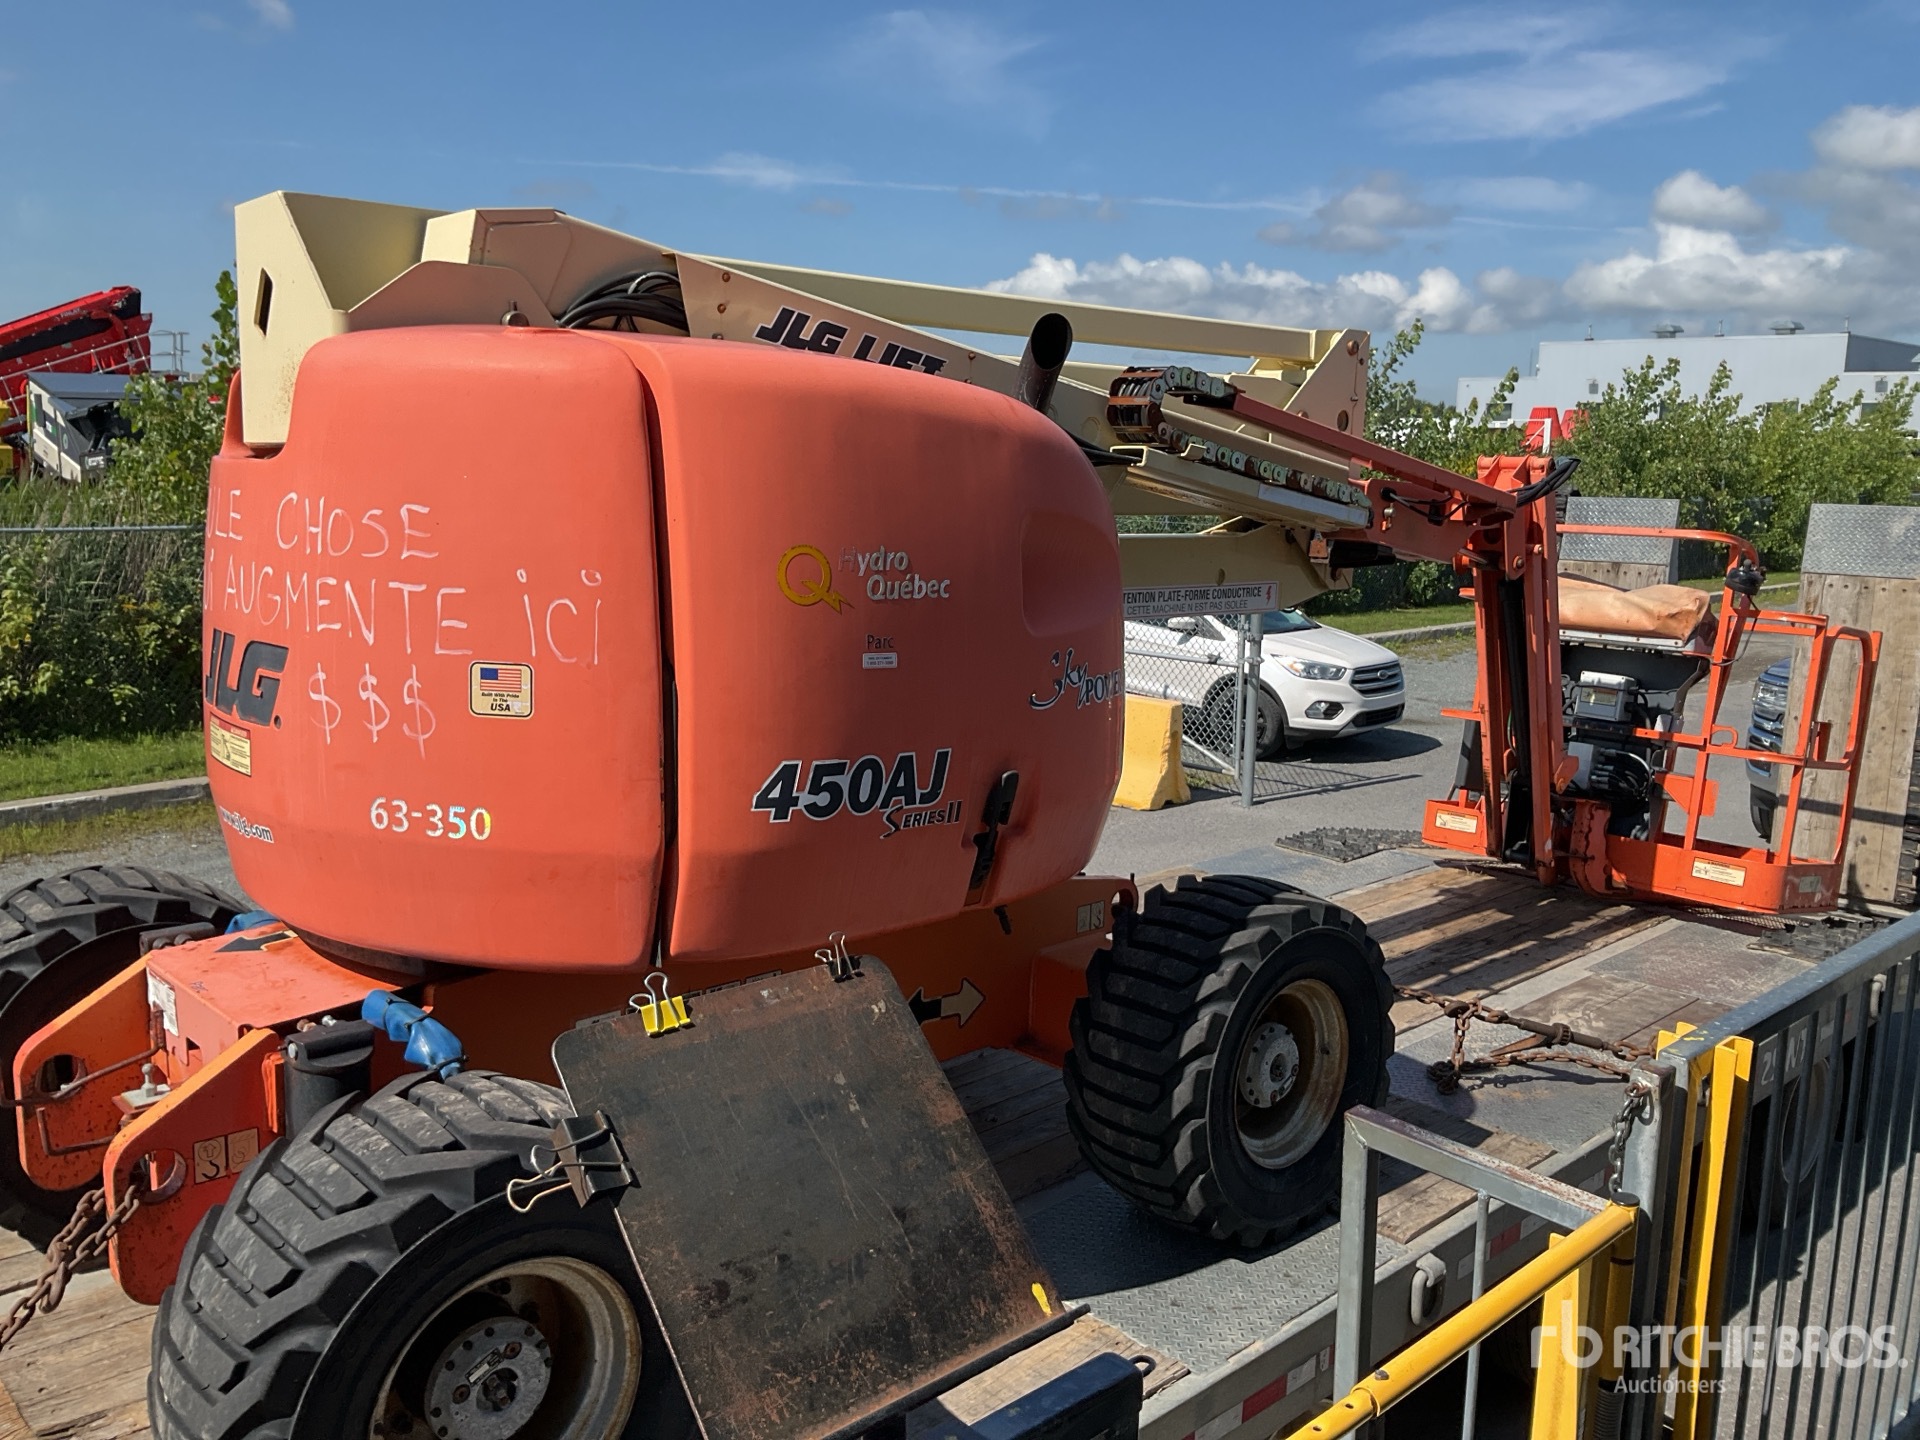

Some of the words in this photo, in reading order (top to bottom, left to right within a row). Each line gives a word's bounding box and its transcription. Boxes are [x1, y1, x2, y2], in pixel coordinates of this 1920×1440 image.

[753, 305, 850, 355] JLG
[276, 491, 439, 559] CHOSE
[223, 553, 473, 655] AUGMENTE
[866, 573, 951, 601] Québec
[1127, 604, 1151, 616] CETTE
[1152, 602, 1186, 614] MACHINE
[1194, 601, 1209, 612] EST
[1209, 600, 1223, 611] PAS
[1157, 589, 1211, 603] PLATE-FORME
[1211, 586, 1262, 600] CONDUCTRICE
[866, 634, 895, 650] Parc
[205, 627, 289, 727] JLG
[490, 703, 511, 712] USA
[752, 748, 952, 822] 450AJ
[370, 797, 493, 841] 63-350
